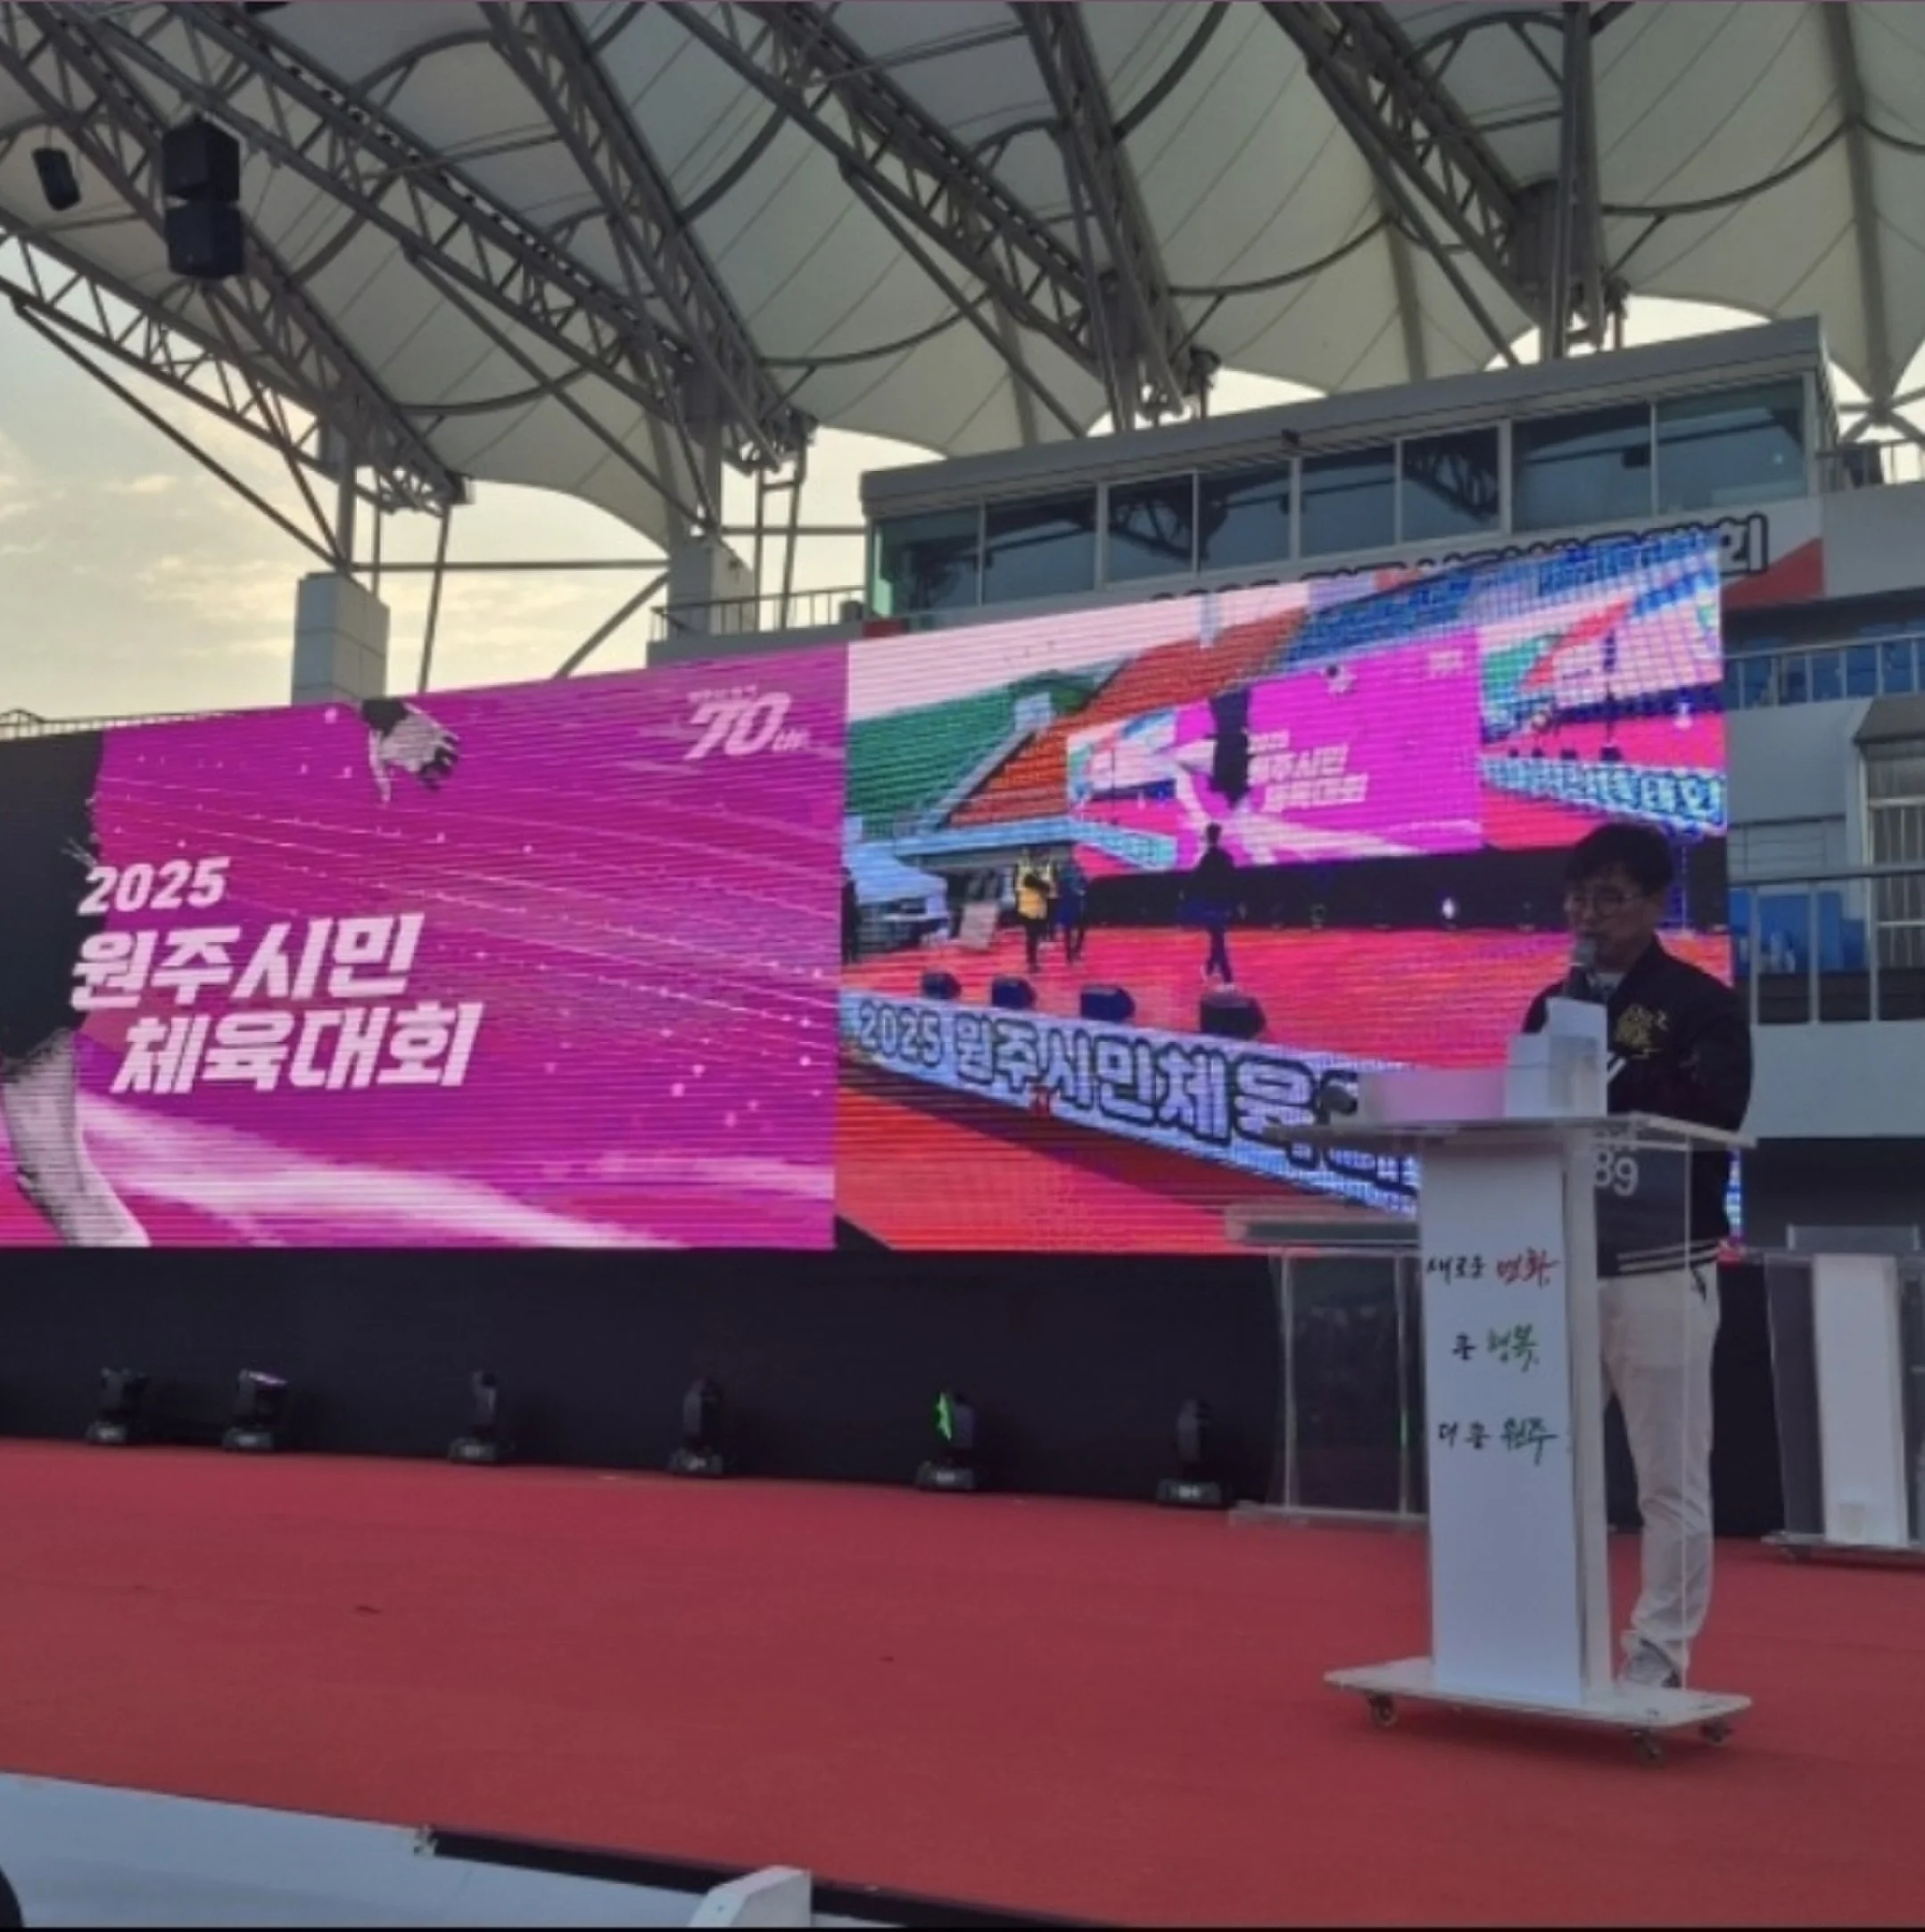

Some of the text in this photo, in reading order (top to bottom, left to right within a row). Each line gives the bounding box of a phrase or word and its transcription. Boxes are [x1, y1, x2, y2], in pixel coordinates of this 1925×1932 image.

[78, 856, 231, 915] 2025
[70, 912, 425, 1011] 원주시민
[109, 1000, 485, 1094] 체육대회
[859, 1001, 943, 1068] 2025
[1594, 1150, 1639, 1197] 89
[1426, 1253, 1487, 1285] 새로운
[1452, 1332, 1477, 1361] 큰
[1438, 1416, 1559, 1466] 더 큰 원주
